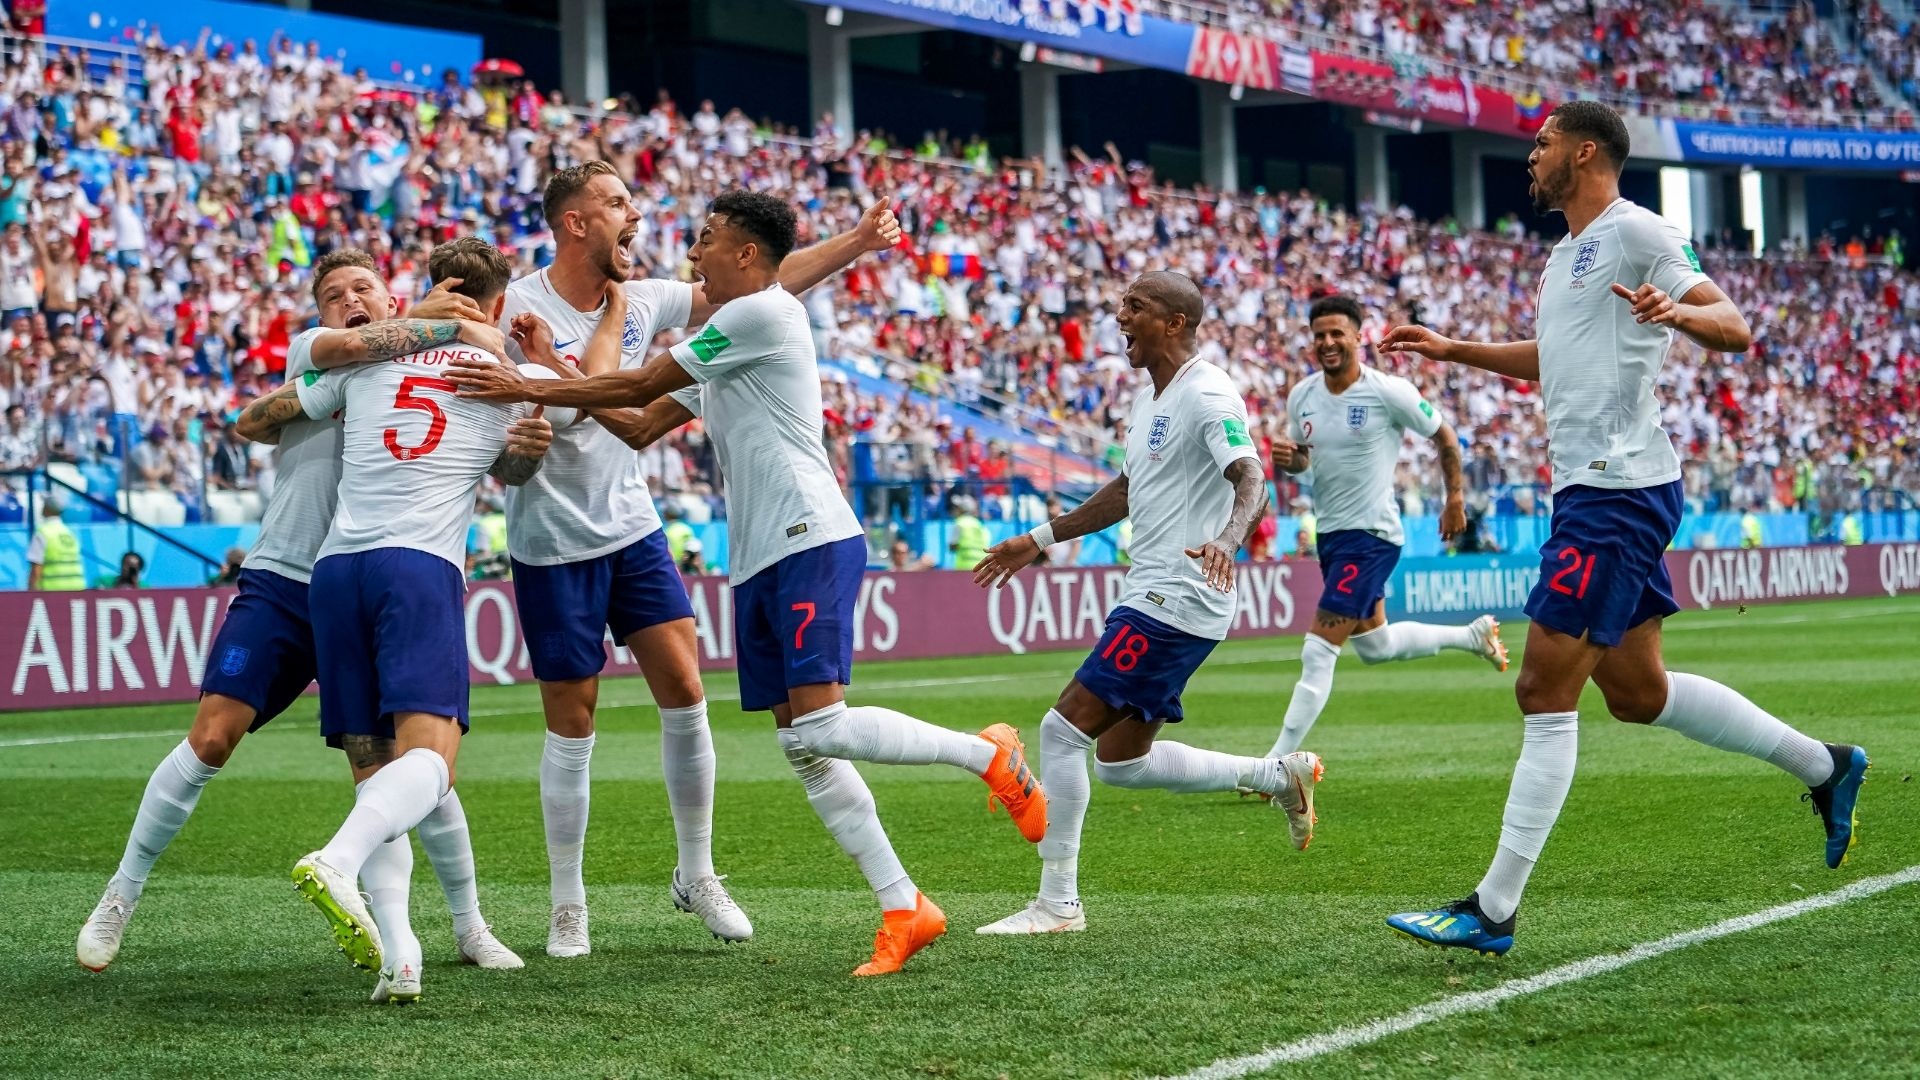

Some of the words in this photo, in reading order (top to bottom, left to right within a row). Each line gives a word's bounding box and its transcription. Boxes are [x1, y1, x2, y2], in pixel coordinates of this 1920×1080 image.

[1844, 138, 1872, 161] ПО
[384, 376, 460, 461] 5
[1337, 564, 1359, 594] 2
[1549, 546, 1596, 600] 21
[1689, 551, 1764, 610] QATAR
[1766, 546, 1849, 598] AIRWAYS
[12, 596, 238, 695] AIRW
[791, 602, 816, 649] 7
[1101, 624, 1149, 672] 18
